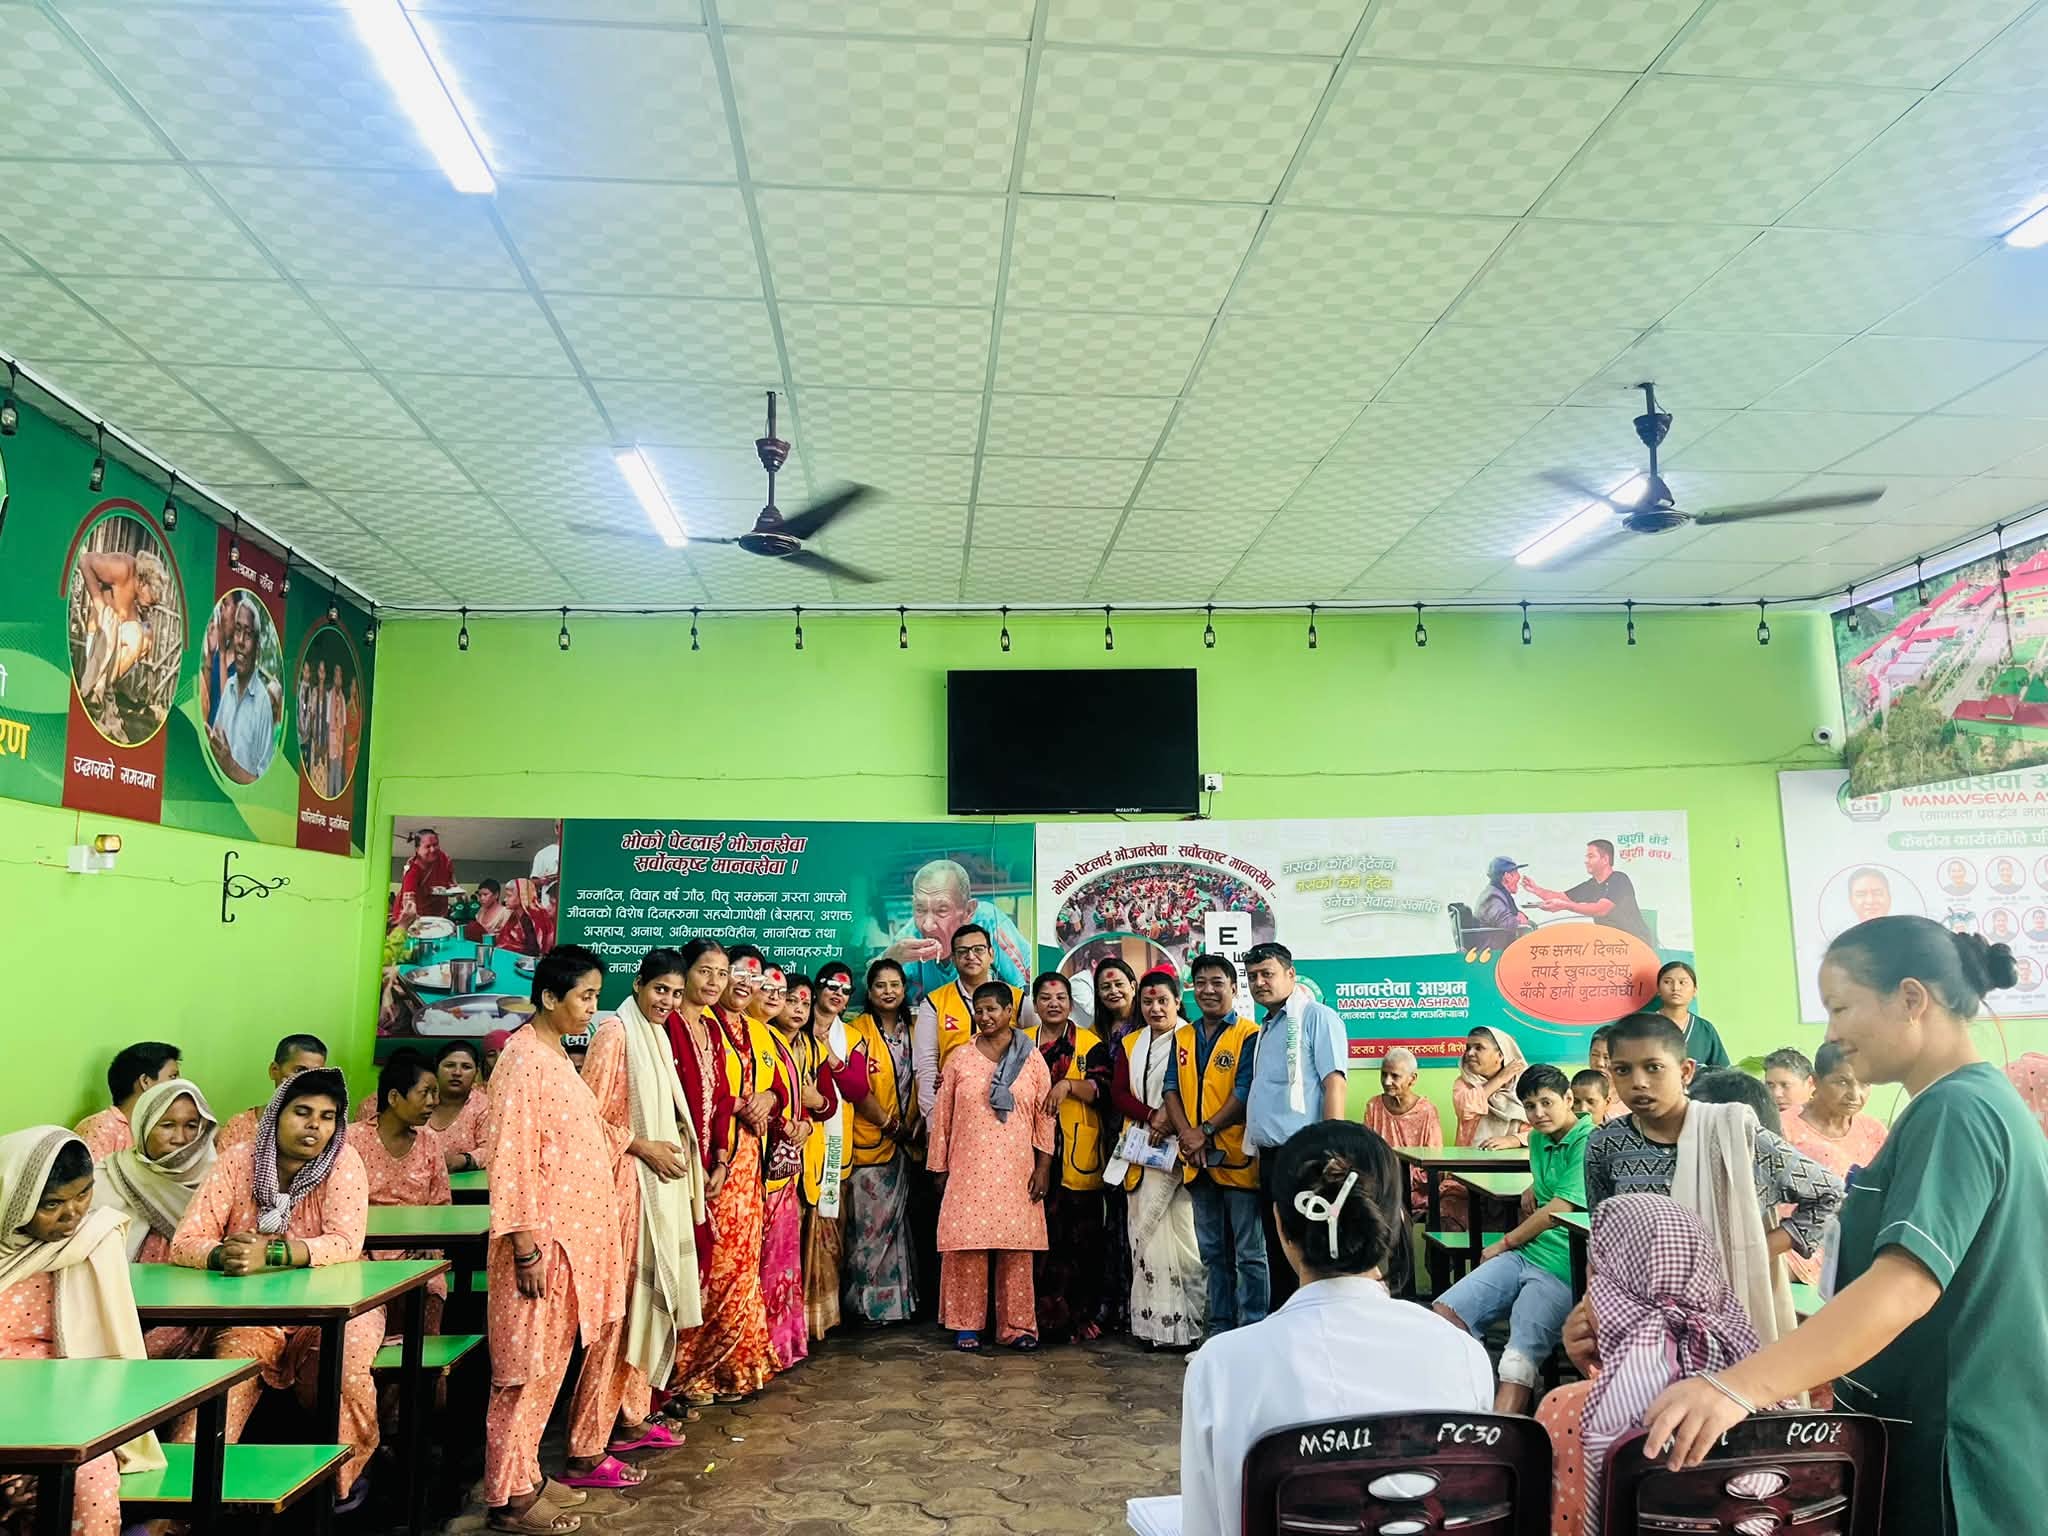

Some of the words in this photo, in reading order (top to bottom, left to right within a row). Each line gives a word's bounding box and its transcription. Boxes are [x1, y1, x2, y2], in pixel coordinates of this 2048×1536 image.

[120, 767, 157, 790] समयमा
[1902, 791, 2029, 807] MANAVSEWA
[621, 831, 664, 850] भोको
[668, 831, 725, 852] पेटलाई
[727, 832, 808, 853] भोजनसेवा
[634, 852, 709, 875] सर्वोत्कृष्ट
[711, 856, 787, 874] मानवसेवा
[1051, 870, 1078, 896] भोको
[1077, 851, 1113, 879] पेटलाई
[1114, 842, 1168, 862] भोजनसेवा
[1178, 843, 1228, 865] सर्वोत्कृष्ट
[1228, 856, 1276, 891] मानवसेवा
[630, 887, 660, 902] विवाह
[664, 887, 679, 901] वर्ष
[781, 891, 810, 903] जस्ता
[814, 889, 848, 903] आफ्नो
[567, 905, 612, 919] जीवनको
[615, 905, 644, 919] विशेष
[647, 906, 700, 920] दिनहरुमा
[763, 926, 812, 939] मानसिक
[815, 928, 836, 939] तथा
[1219, 927, 1238, 945] E
[1530, 945, 1550, 960] एक
[1594, 939, 1630, 957] दिनको
[1335, 978, 1412, 997] मानवसेवा
[1416, 981, 1468, 996] आश्रम
[1550, 981, 1576, 1000] हामी
[1338, 998, 1415, 1009] MANAVSEWA
[1417, 996, 1468, 1008] ASHRAM
[1437, 1423, 1501, 1446] PC30
